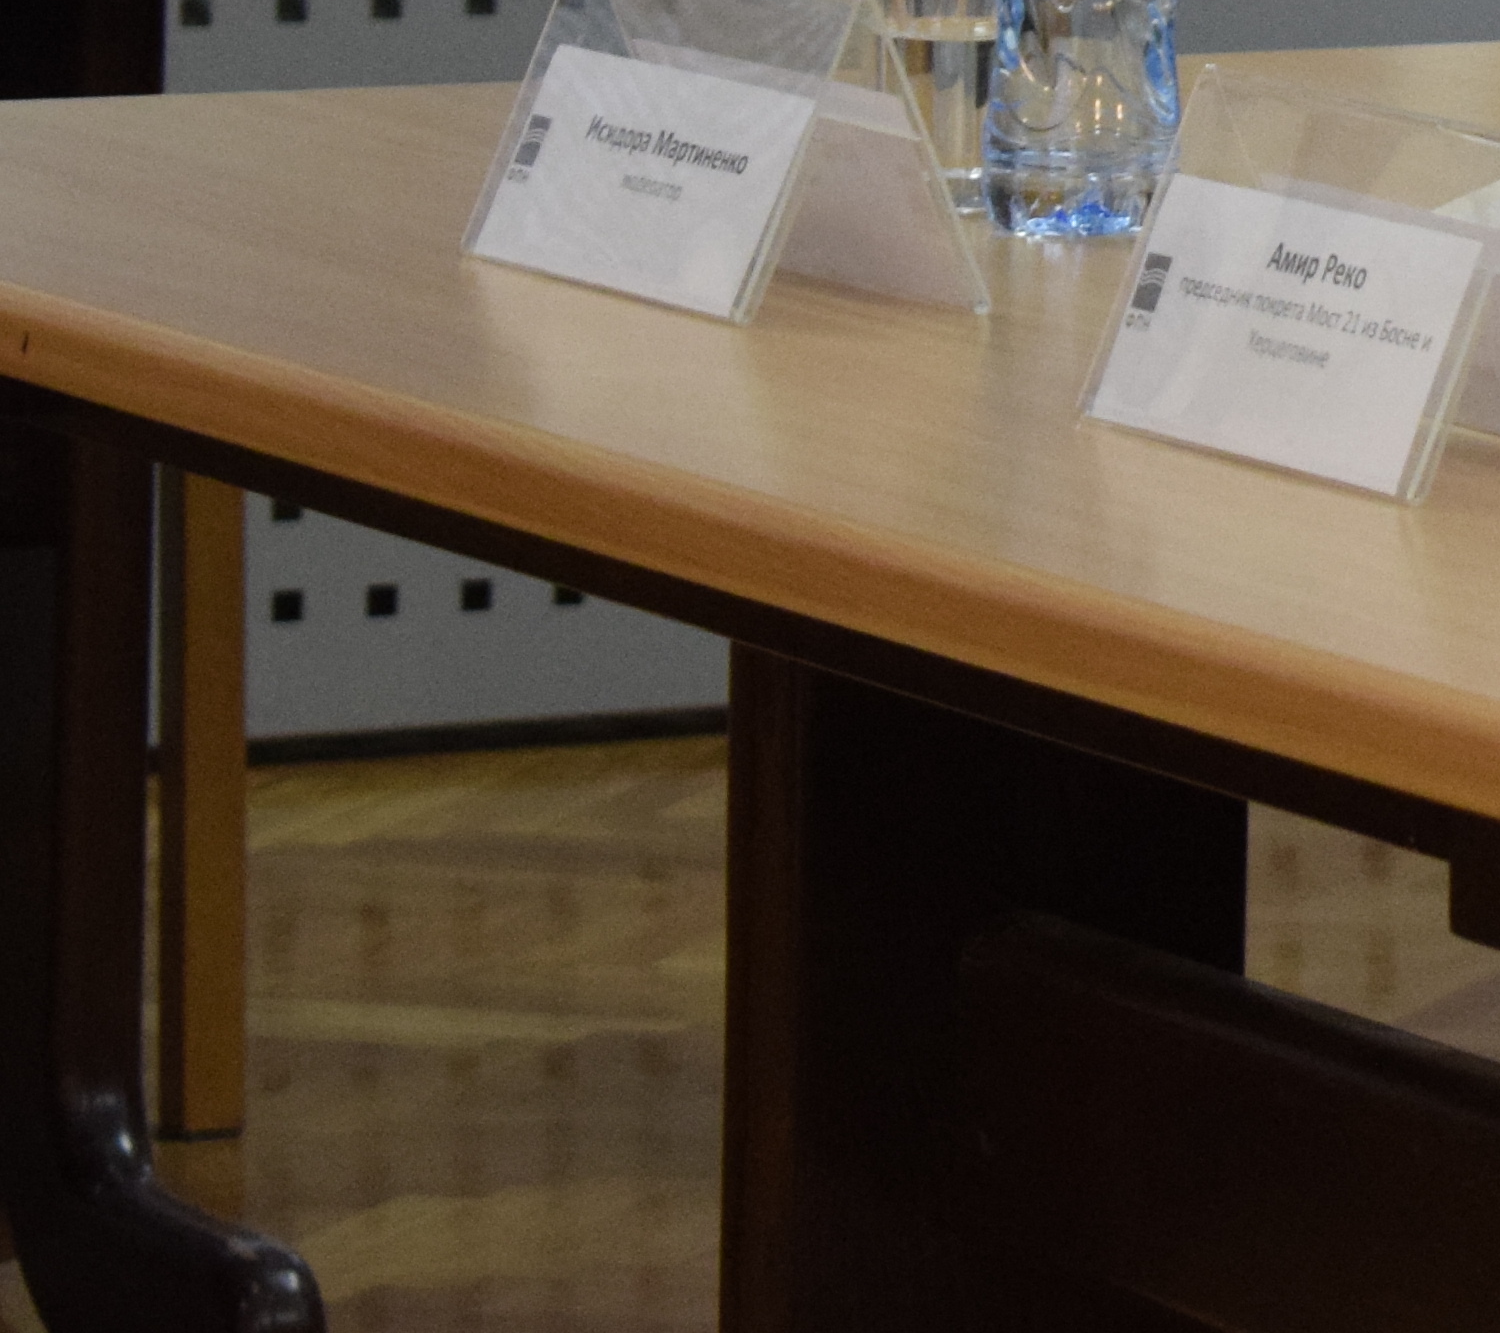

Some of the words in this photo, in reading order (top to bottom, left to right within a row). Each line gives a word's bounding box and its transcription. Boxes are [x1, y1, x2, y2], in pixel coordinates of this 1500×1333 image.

[586, 114, 651, 155] Исидора
[652, 130, 749, 175] Мартиненко
[1266, 242, 1320, 284] Амир
[1321, 253, 1367, 290] Реко
[1341, 310, 1361, 334] 21
